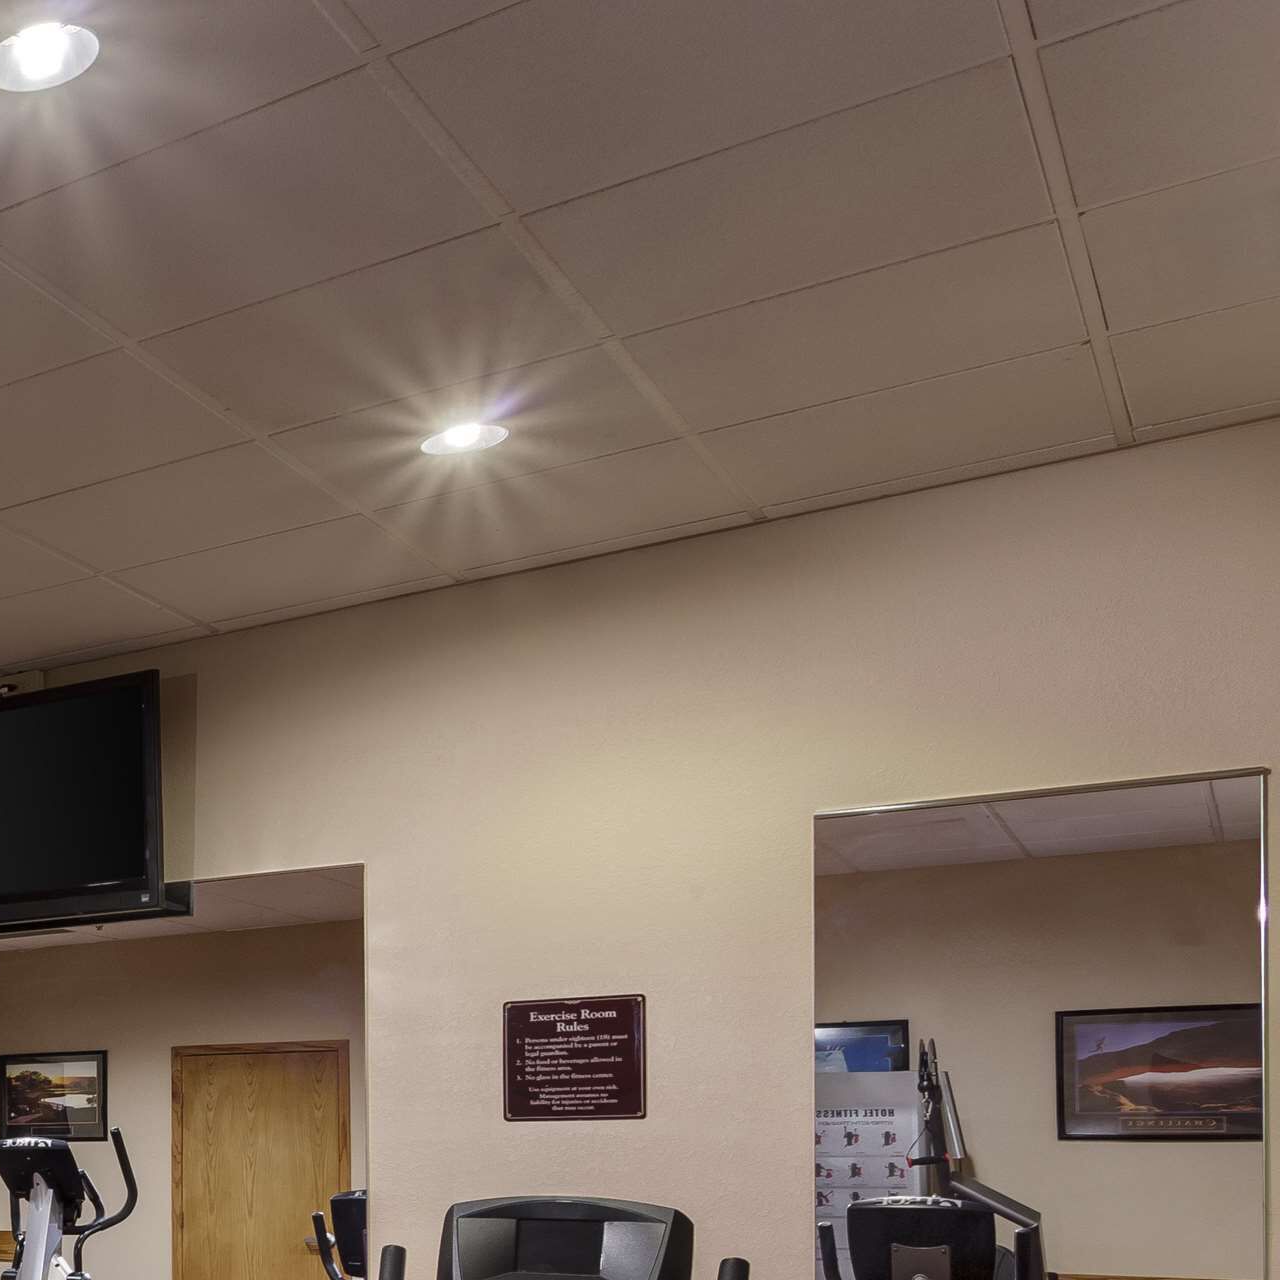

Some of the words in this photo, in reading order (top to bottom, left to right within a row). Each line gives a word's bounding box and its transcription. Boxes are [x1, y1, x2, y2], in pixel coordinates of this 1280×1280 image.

[529, 1010, 578, 1022] Exercise
[580, 1008, 617, 1020] Room
[556, 1021, 590, 1032] Rules
